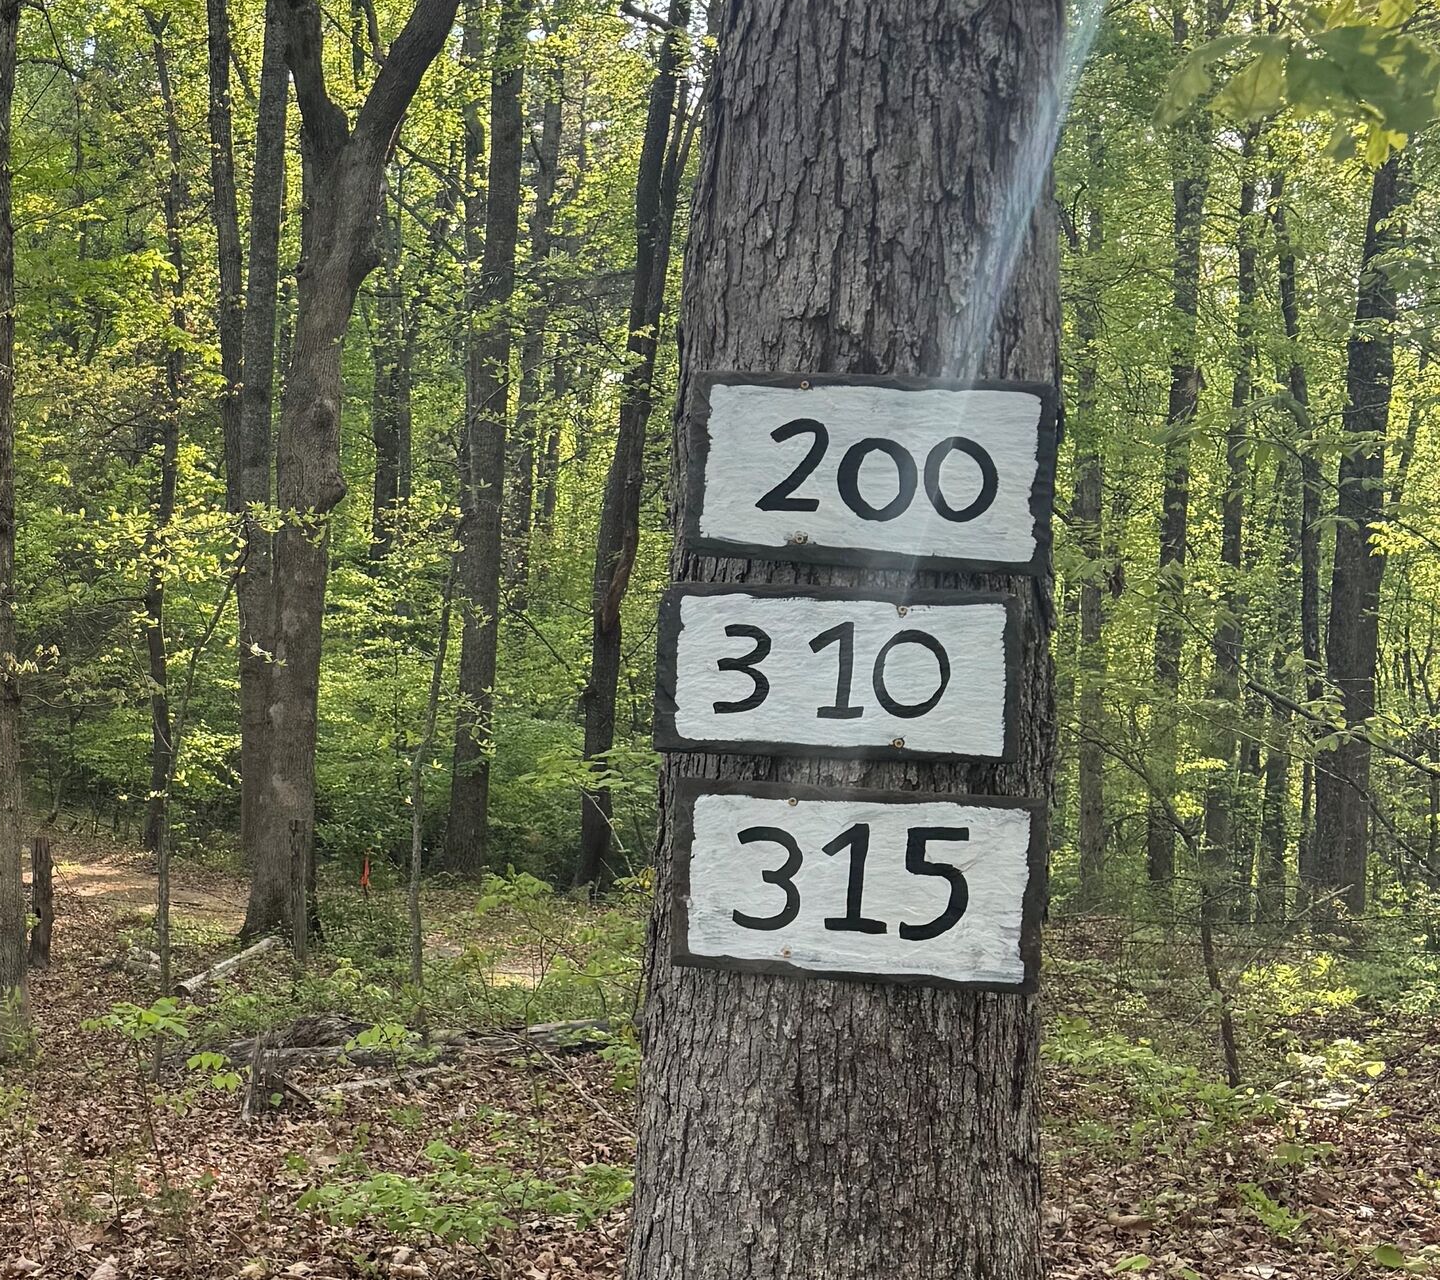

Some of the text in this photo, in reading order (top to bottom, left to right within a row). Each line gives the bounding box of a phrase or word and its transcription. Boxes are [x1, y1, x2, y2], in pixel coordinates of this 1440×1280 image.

[754, 418, 1000, 523] 200
[712, 621, 951, 720] 310
[731, 823, 970, 942] 315
